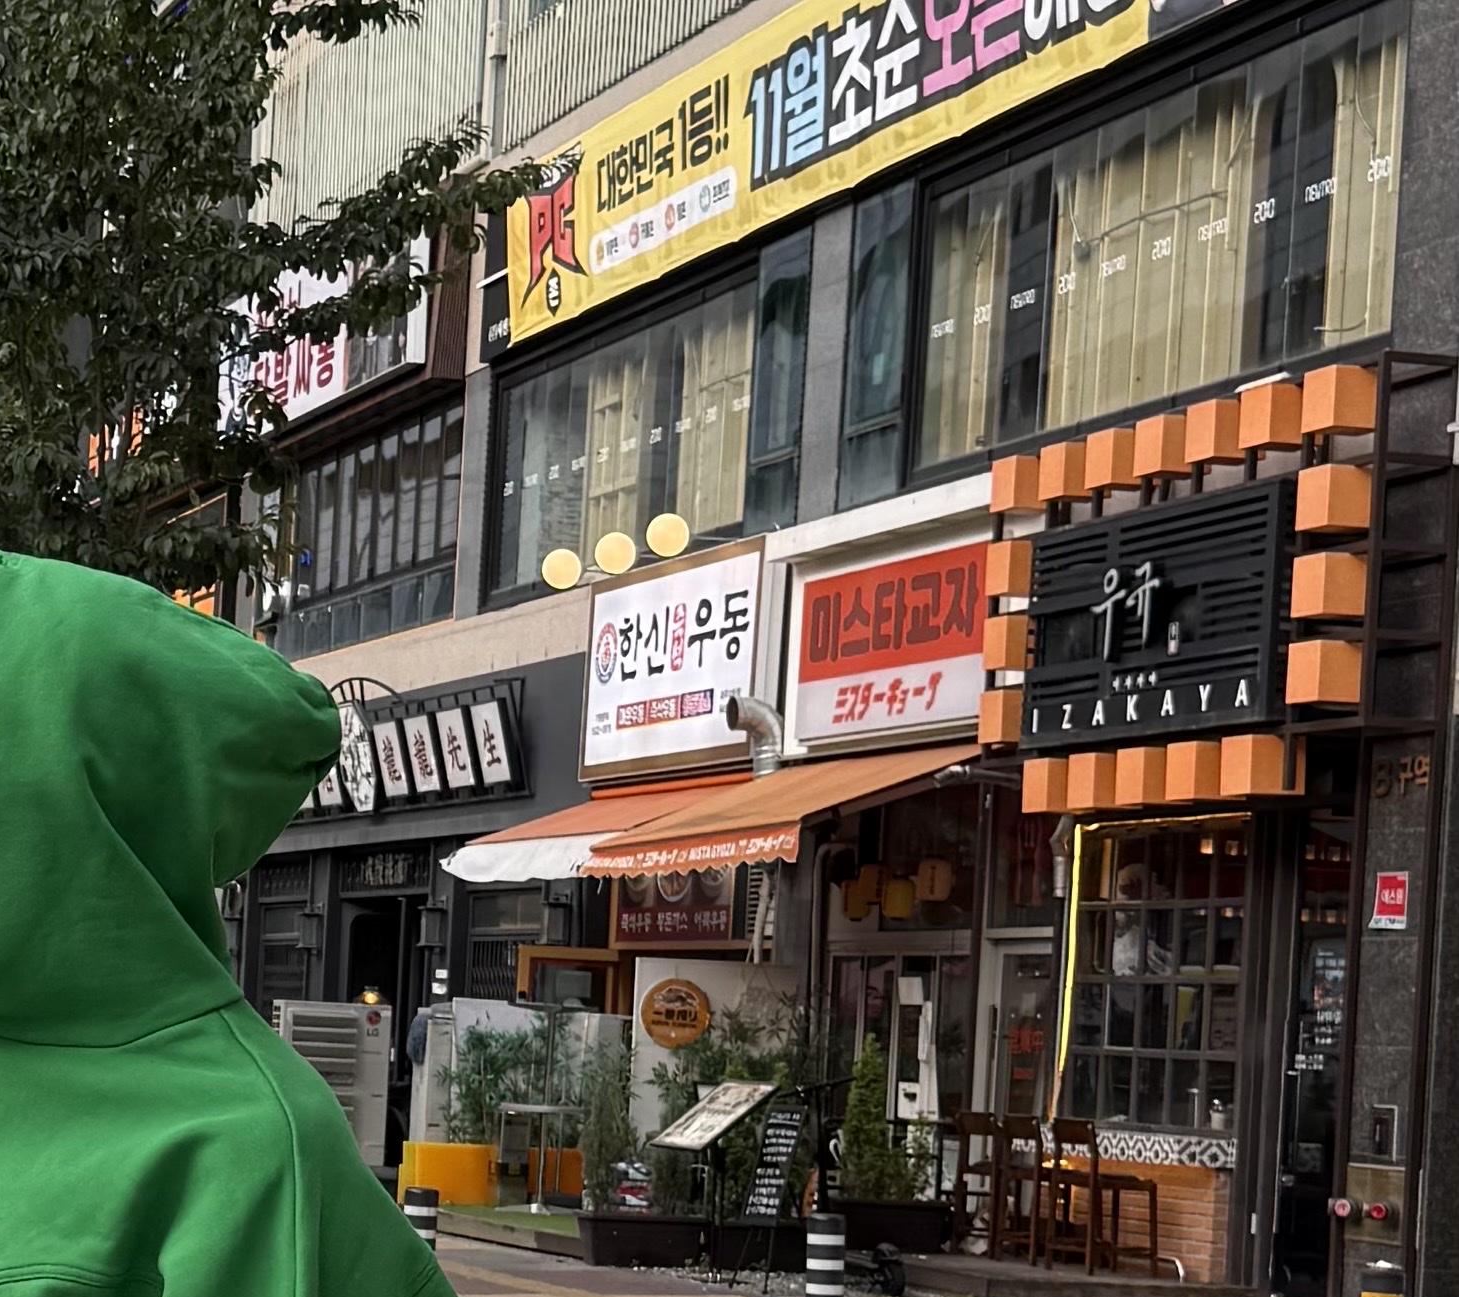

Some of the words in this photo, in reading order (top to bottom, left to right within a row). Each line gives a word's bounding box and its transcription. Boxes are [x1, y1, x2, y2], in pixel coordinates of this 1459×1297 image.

[596, 117, 675, 214] 대한민국
[619, 605, 670, 683] 한신
[688, 589, 751, 669] 우동
[809, 561, 979, 664] 미스타교자
[1091, 561, 1161, 662] 우규
[1031, 678, 1249, 734] IZAKAYA
[366, 1027, 379, 1037] LG
